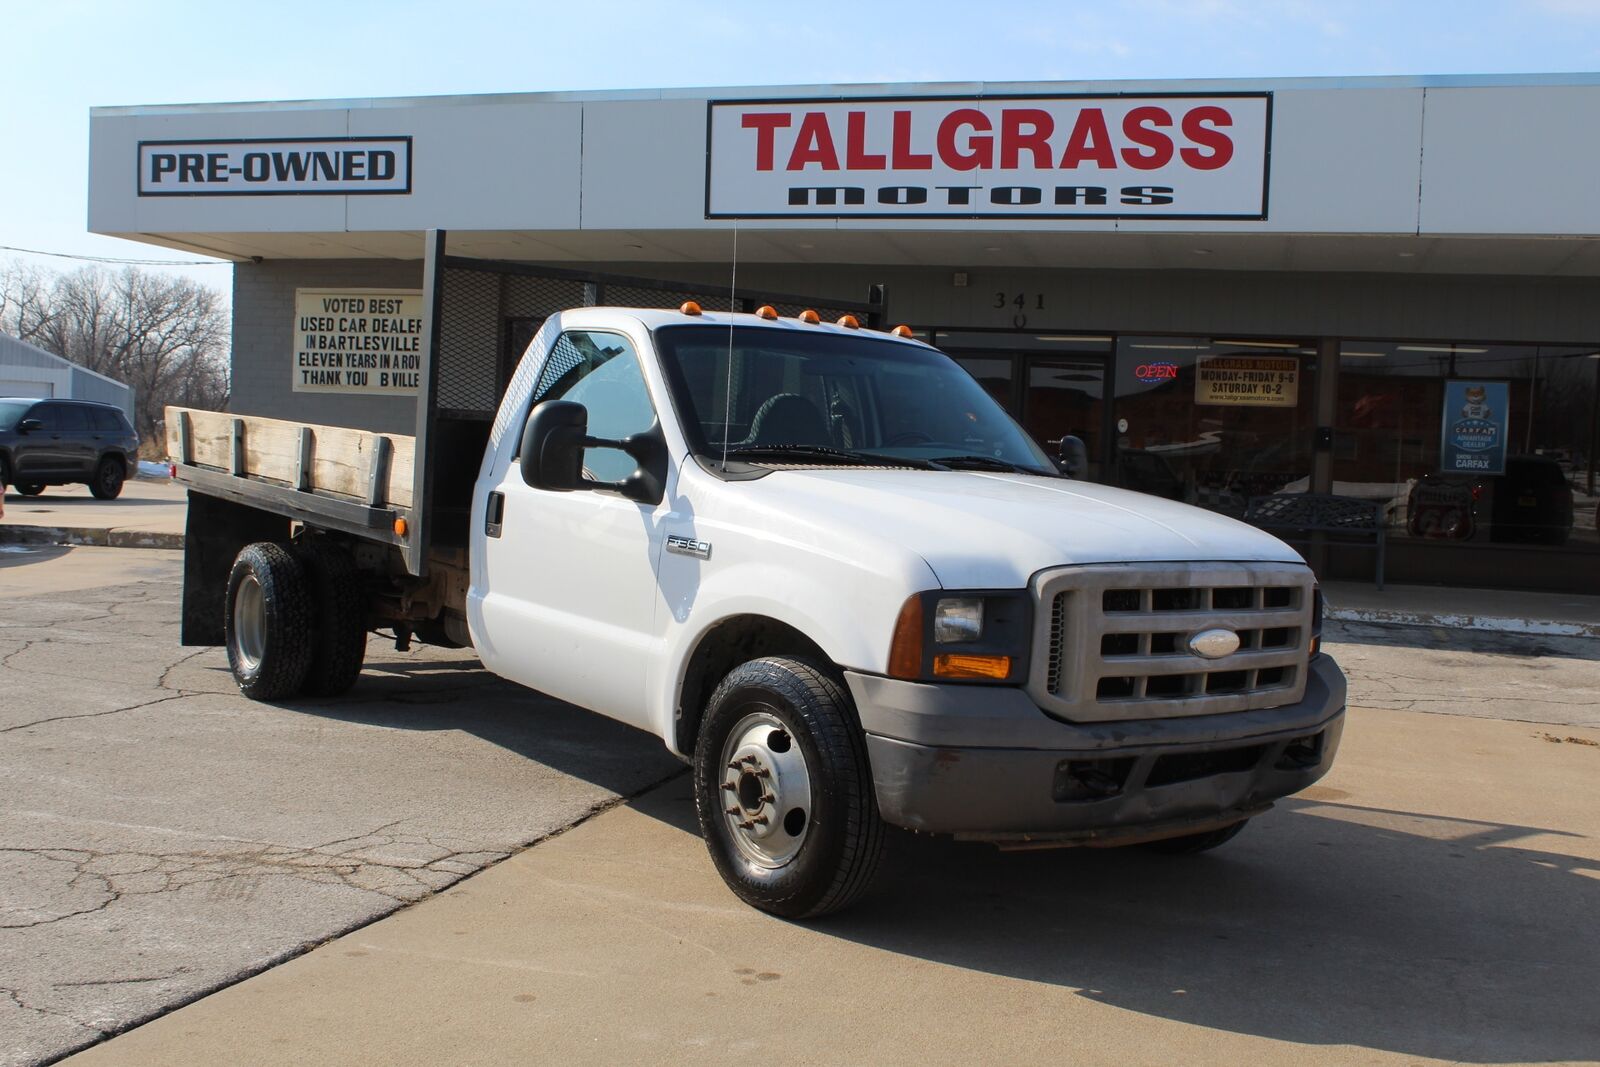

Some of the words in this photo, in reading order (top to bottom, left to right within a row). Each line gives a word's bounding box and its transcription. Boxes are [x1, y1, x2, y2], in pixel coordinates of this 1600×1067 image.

[741, 105, 1234, 171] TALLGRASS
[151, 150, 395, 183] PRE-OWNED
[788, 186, 1174, 206] MOTORS
[323, 298, 365, 313] VOTED
[369, 299, 403, 314] BEST
[992, 292, 1045, 310] 341
[301, 317, 334, 332] USED
[339, 317, 367, 333] CAR
[306, 334, 316, 349] IN
[319, 335, 420, 351] BARTLESVILLE
[299, 352, 343, 367] ELEVEN
[346, 353, 377, 368] YEARS
[380, 354, 390, 369] IN
[392, 354, 399, 369] A
[302, 370, 341, 385] THANK
[346, 371, 368, 386] YOU
[380, 372, 389, 387] B
[392, 372, 419, 388] VILLE
[1135, 364, 1178, 379] OPEN
[1201, 370, 1275, 382] MONDAY-FRIDAY
[1212, 382, 1258, 394] SATURDAY
[1262, 383, 1282, 395] 10-2
[1456, 459, 1489, 469] CARFAX
